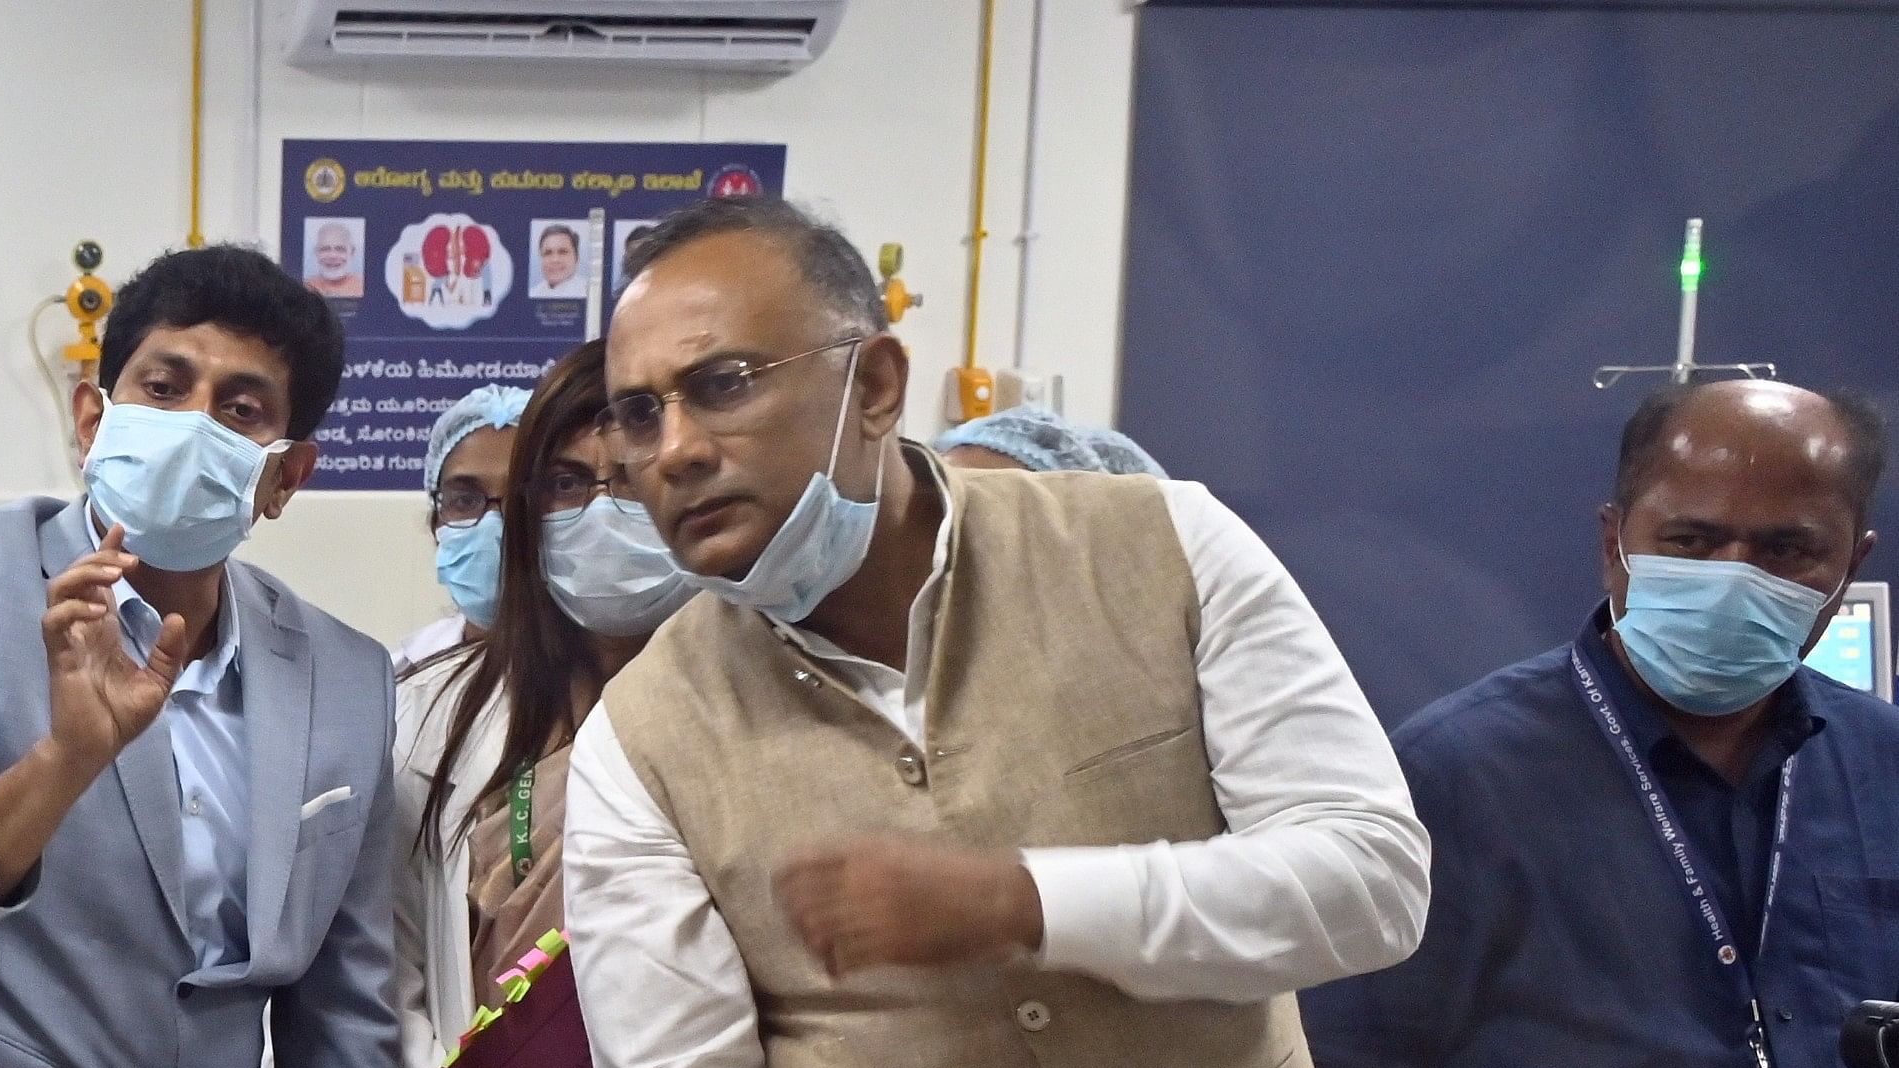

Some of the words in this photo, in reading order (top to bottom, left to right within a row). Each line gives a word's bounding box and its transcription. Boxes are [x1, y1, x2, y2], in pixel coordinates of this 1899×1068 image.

[438, 168, 485, 196] ಮತ್ತು
[1587, 687, 1603, 703] Of
[1599, 703, 1621, 734] Govt.
[1648, 793, 1677, 841] Welfare
[1672, 842, 1699, 885] Family
[1692, 885, 1704, 897] &
[1699, 898, 1724, 941] Health
